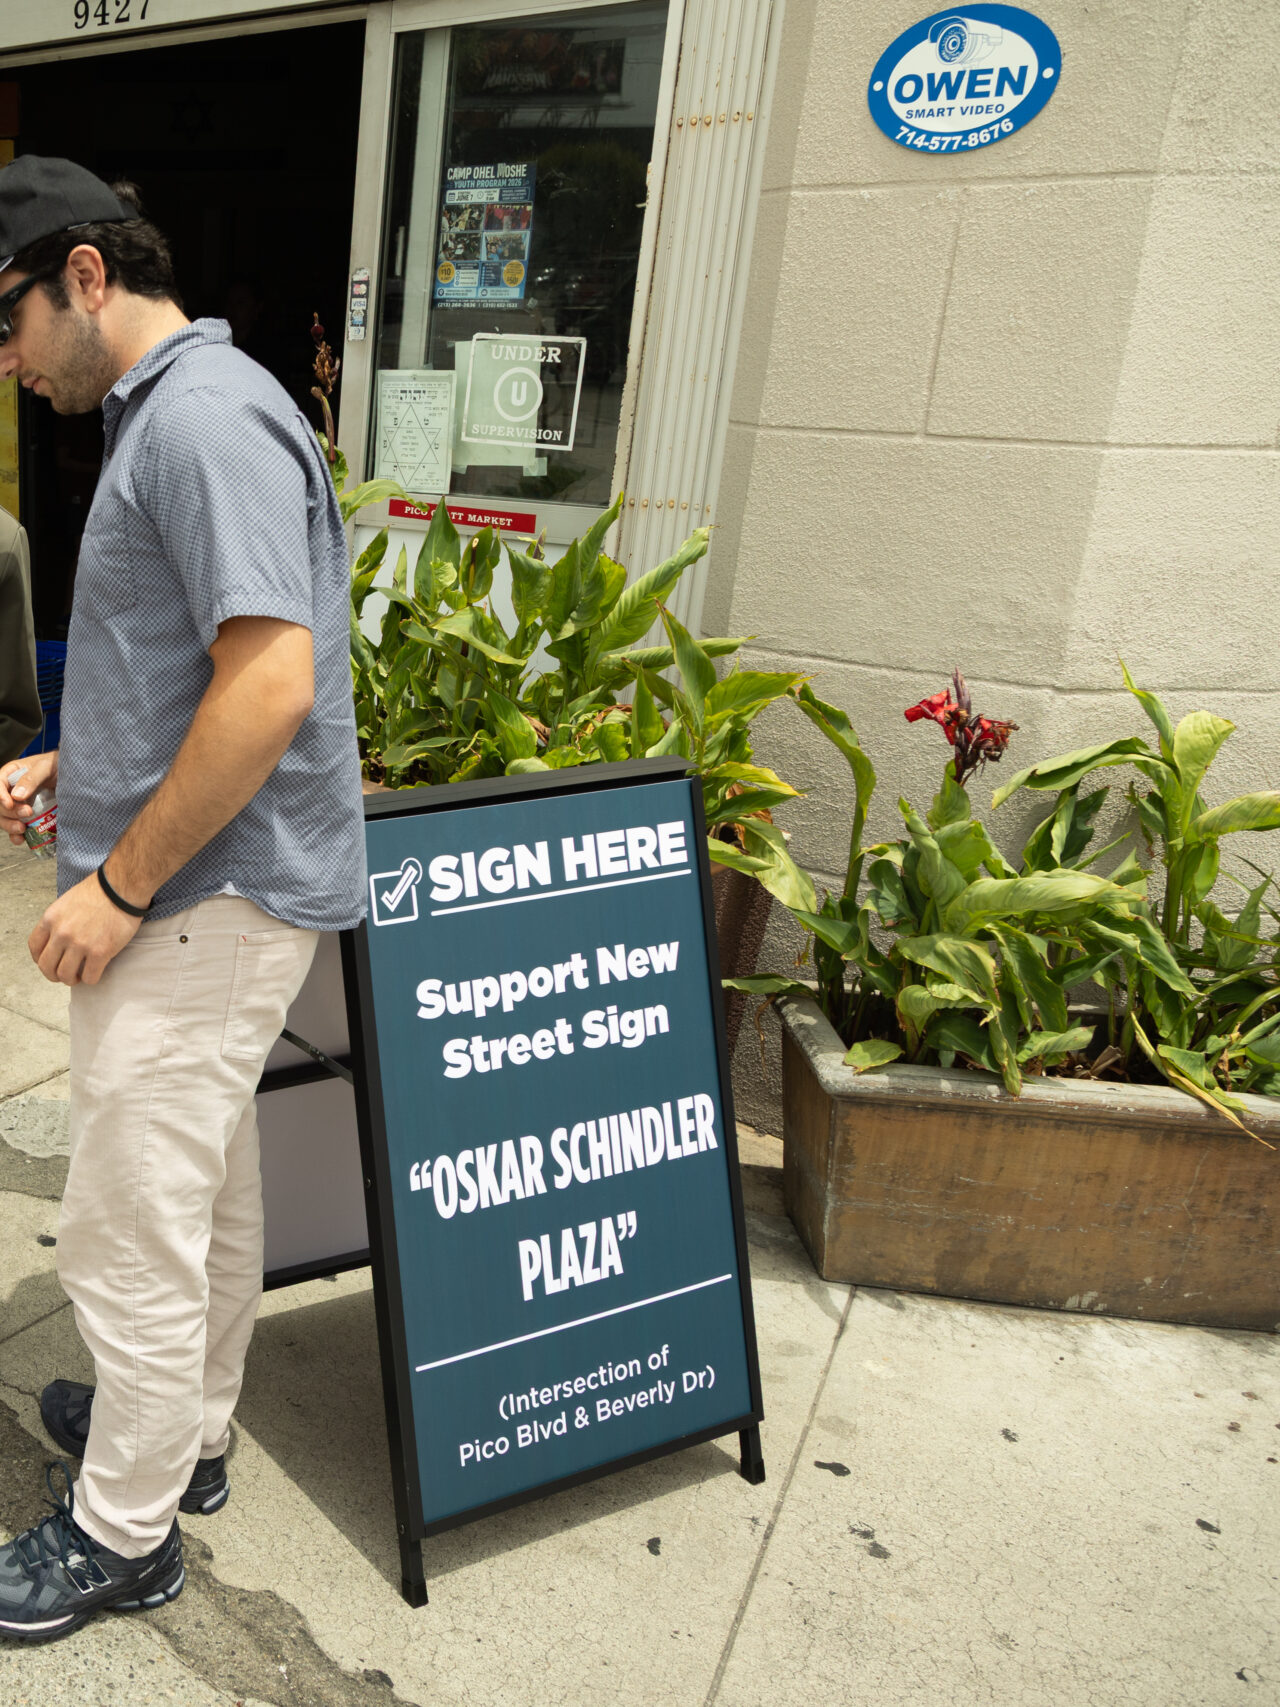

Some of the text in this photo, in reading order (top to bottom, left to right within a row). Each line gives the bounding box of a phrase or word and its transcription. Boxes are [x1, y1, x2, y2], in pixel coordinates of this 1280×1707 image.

[74, 0, 149, 29] 9427
[894, 65, 1028, 104] OWEN
[905, 104, 1005, 119] SMART VIDEO
[895, 118, 1014, 150] 714-577-8676
[447, 163, 527, 180] CAMP OHEL MOSHE
[454, 180, 475, 188] YOUTH
[476, 179, 507, 188] PROGRAM
[491, 344, 561, 363] UNDER
[511, 381, 527, 406] U
[471, 424, 563, 441] SUPERVISION
[404, 506, 428, 516] PICO
[467, 513, 513, 526] MARKET
[429, 821, 688, 902] SIGN HERE
[416, 941, 679, 1019] Support New
[443, 1004, 670, 1078] Street Sign
[410, 1093, 718, 1219] “OSKAR SCHINDLER
[519, 1211, 637, 1301] PLAZA”
[498, 1344, 670, 1422] (Intersection of
[459, 1365, 715, 1467] Pico Blvd & Beverly Dr)
